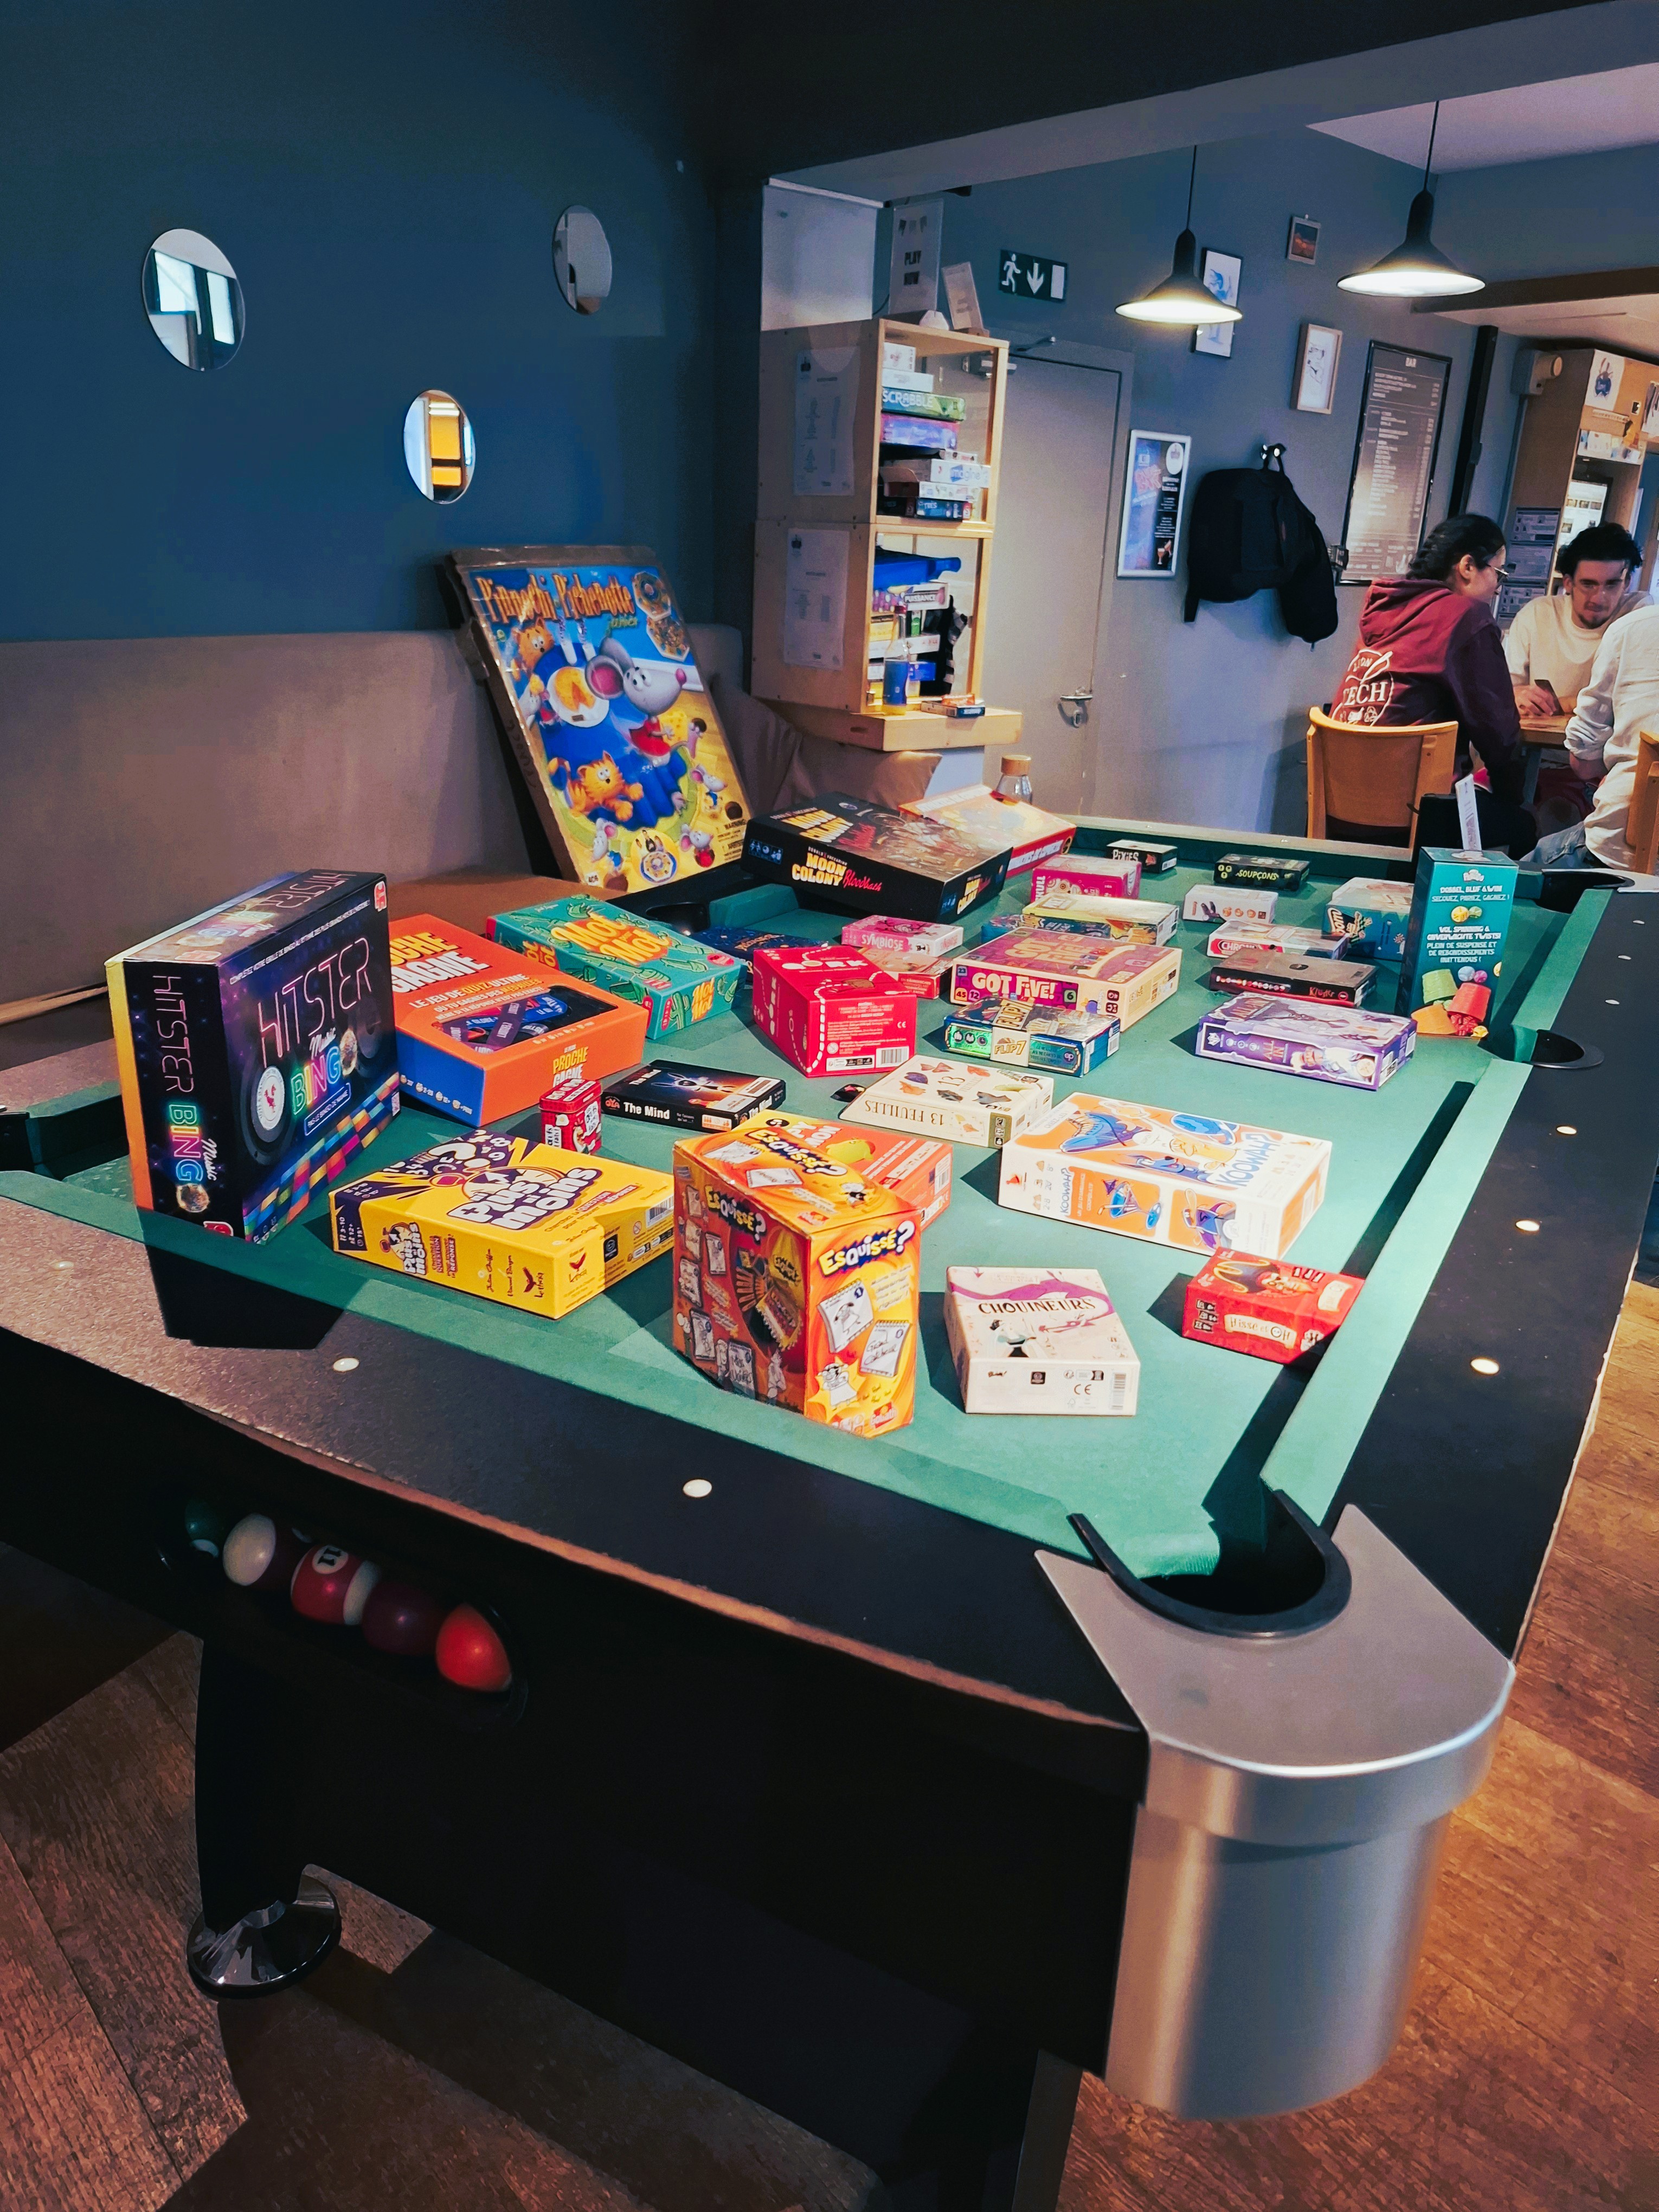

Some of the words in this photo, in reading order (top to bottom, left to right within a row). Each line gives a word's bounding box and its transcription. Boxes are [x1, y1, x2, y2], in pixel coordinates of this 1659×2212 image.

[883, 389, 934, 407] SCRABBLE
[792, 864, 843, 886] COLONY
[806, 852, 847, 877] MOON
[1238, 869, 1278, 880] SOUPÇONS
[1034, 876, 1046, 901] KULL
[551, 911, 627, 950] Mot
[600, 929, 672, 966] Mot
[390, 951, 490, 993] GAGNE
[972, 972, 1012, 993] GOT
[257, 937, 372, 1068] HITSTER
[408, 999, 426, 1009] LE
[426, 992, 447, 1006] JEU
[447, 987, 462, 999] DE
[461, 980, 490, 995] QUIZ
[487, 973, 530, 988] ULTIME
[956, 989, 967, 998] 45
[969, 990, 980, 999] 12
[1067, 991, 1074, 999] 6
[152, 975, 194, 1092] HITSTER
[552, 1046, 588, 1075] PROCHE
[552, 1063, 583, 1088] GAGNE
[623, 1102, 642, 1115] The
[644, 1105, 670, 1120] Mind
[865, 1099, 925, 1122] FEUILLES
[931, 1113, 944, 1126] 13
[448, 1181, 542, 1224] Plus
[491, 1168, 597, 1230] moins
[576, 1192, 611, 1212] QUESTION
[403, 1239, 416, 1274] Plus
[409, 1222, 427, 1275] moins
[434, 1237, 443, 1272] QUESTION
[978, 1299, 1096, 1314] CHOUINEURS
[1230, 1316, 1258, 1332] Hisse
[1270, 1326, 1291, 1341] OH
